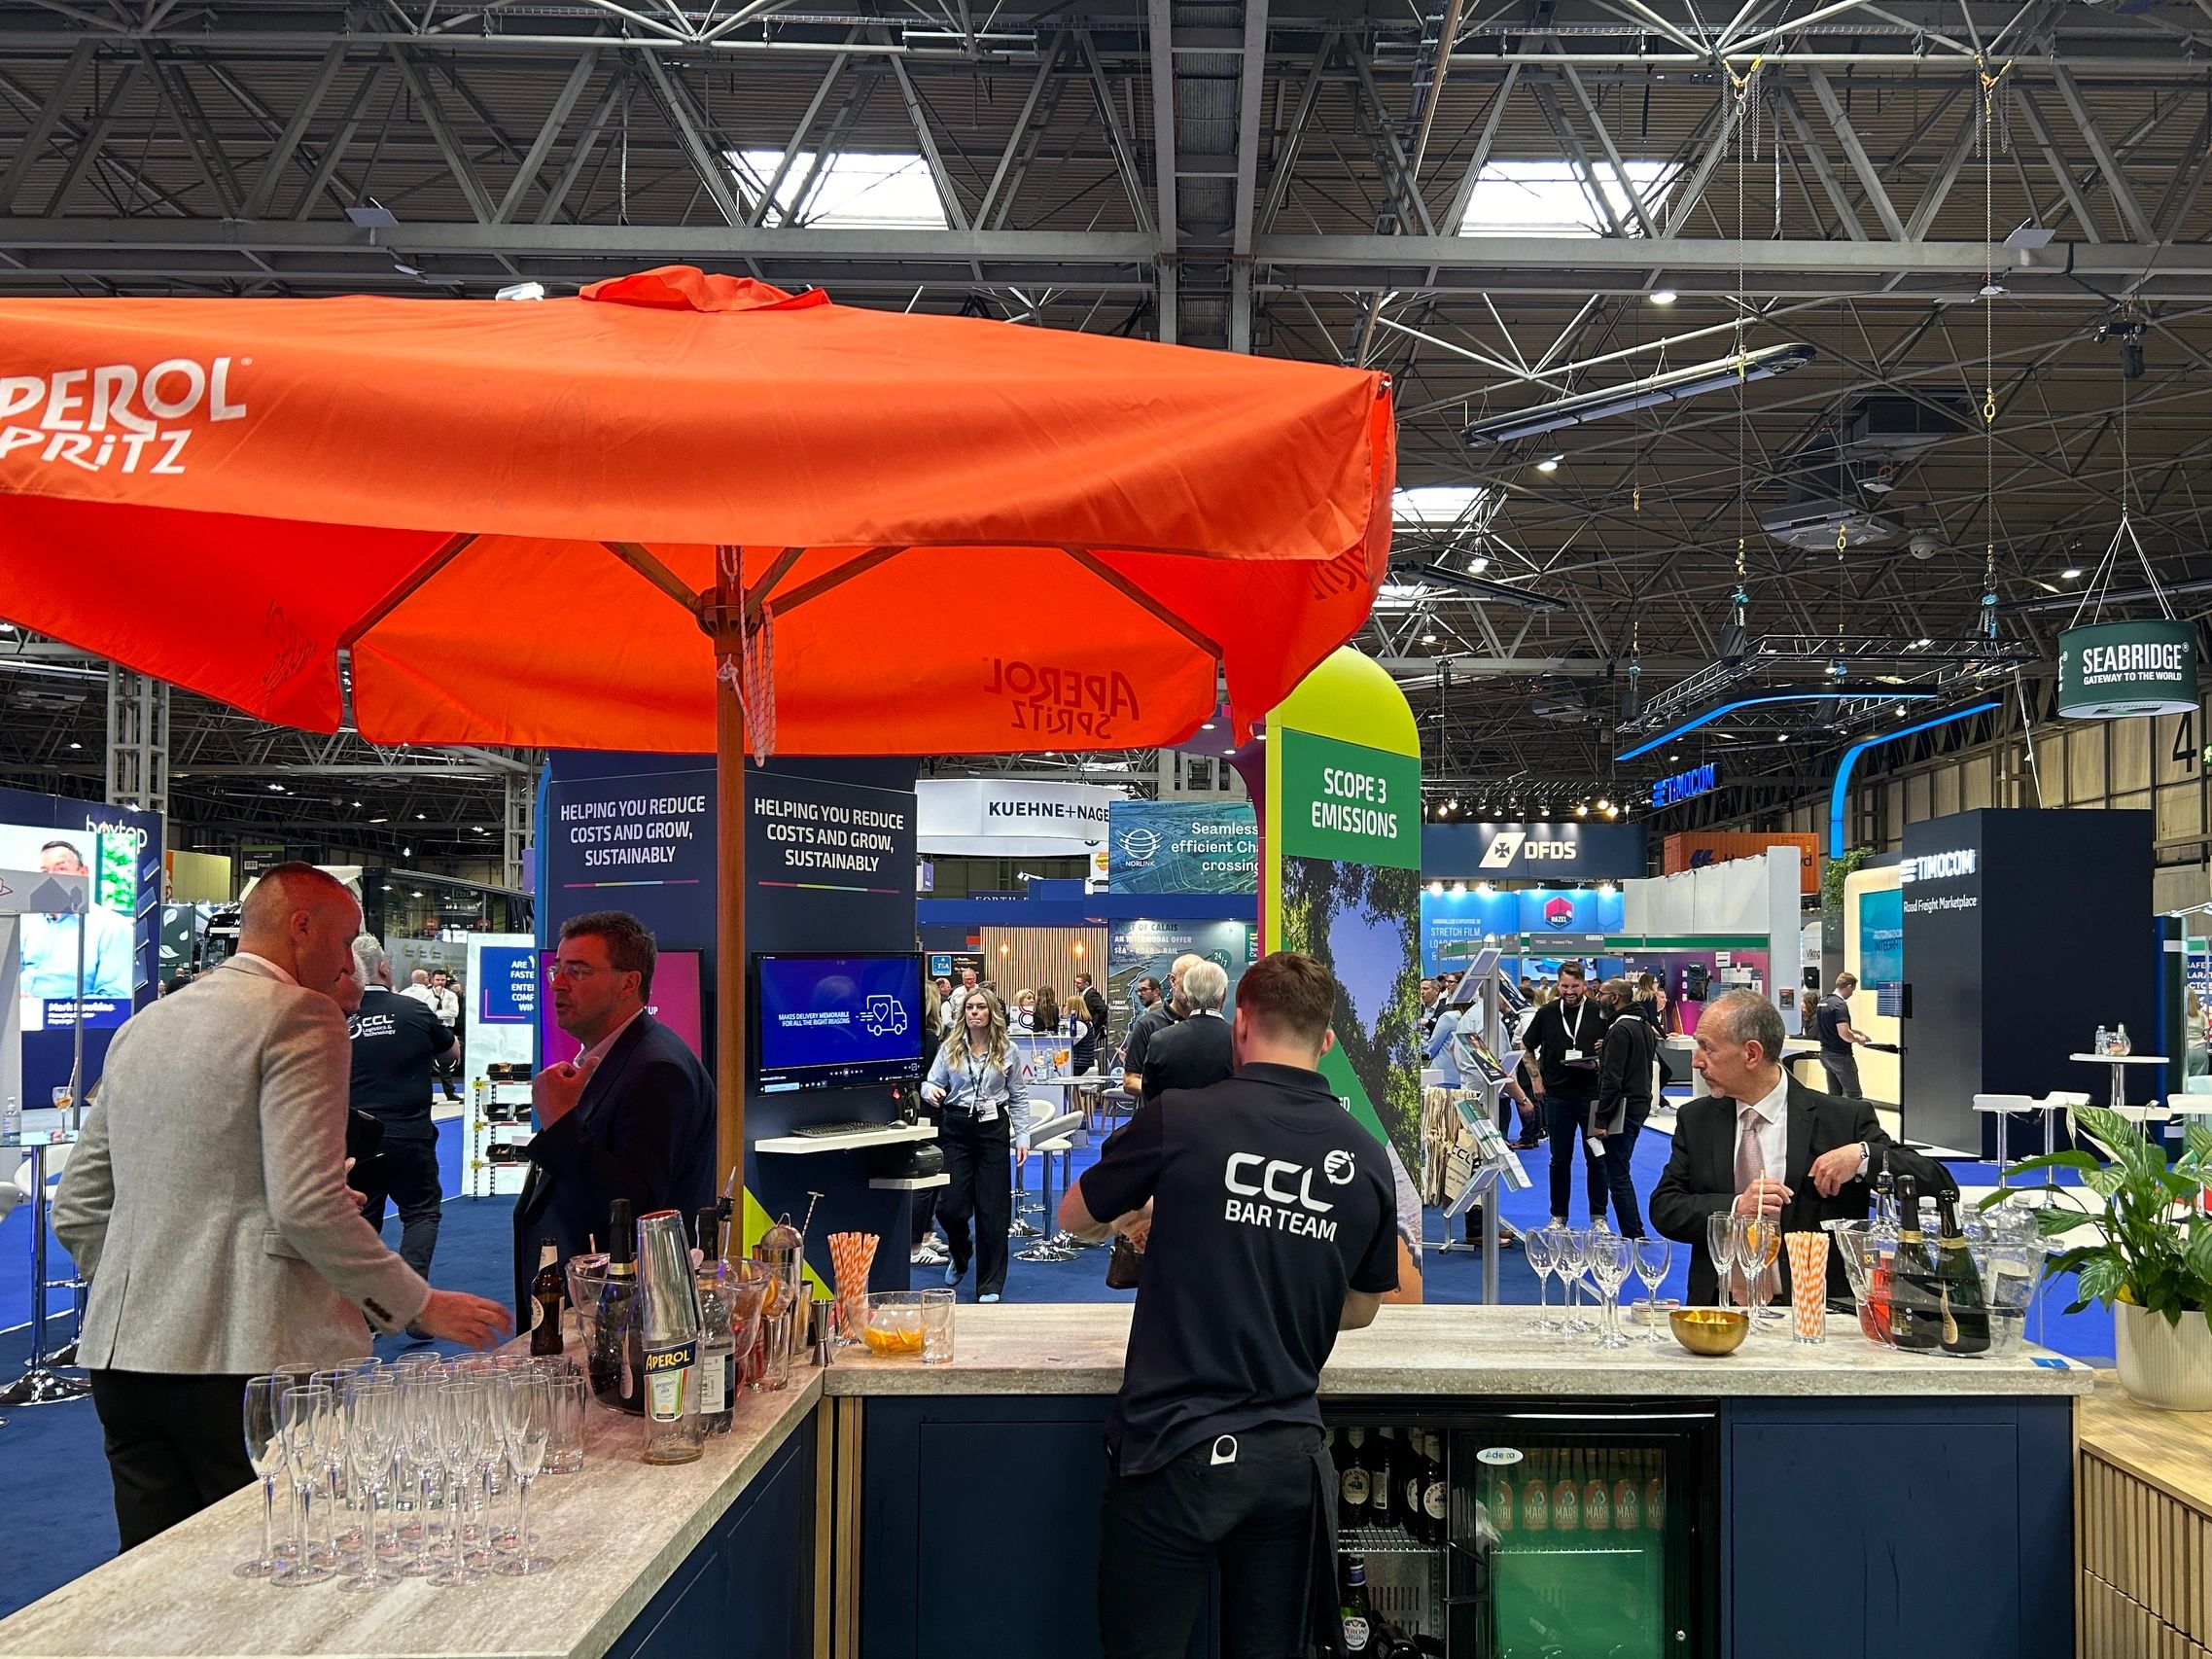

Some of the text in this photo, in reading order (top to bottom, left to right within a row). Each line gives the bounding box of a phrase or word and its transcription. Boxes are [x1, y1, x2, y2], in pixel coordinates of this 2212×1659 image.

[2084, 671, 2182, 686] GATEWAY TO THE WORLD
[2172, 711, 2197, 773] 4
[1323, 767, 1387, 804] SCOPE 3
[560, 795, 705, 821] HELPING YOU REDUCE
[755, 797, 904, 830] HELPING YOU REDUCE
[1191, 822, 1258, 835] Seamless
[1312, 800, 1397, 839] EMISSIONS
[570, 821, 693, 843] COSTS AND GROW,
[767, 824, 894, 854] COSTS AND GROW,
[585, 846, 676, 866] SUSTAINABLY
[1171, 840, 1233, 853] efficient
[1525, 841, 1576, 860] DFDS
[785, 849, 879, 871] SUSTAINABLY
[1916, 848, 1976, 881] TIMOCOM
[1904, 894, 1977, 914] Road Freight Marketplace
[1431, 927, 1462, 936] STRETCH
[1213, 952, 1228, 968] 24/7
[1431, 952, 1437, 961] &
[362, 1014, 395, 1027] CCL
[648, 1006, 658, 1015] UP
[778, 1011, 850, 1021] MAKES DELIVERY MEMORABLE
[1225, 1151, 1334, 1213] CCL
[1224, 1199, 1338, 1243] BAR TEAM
[646, 1349, 690, 1372] APEROL
